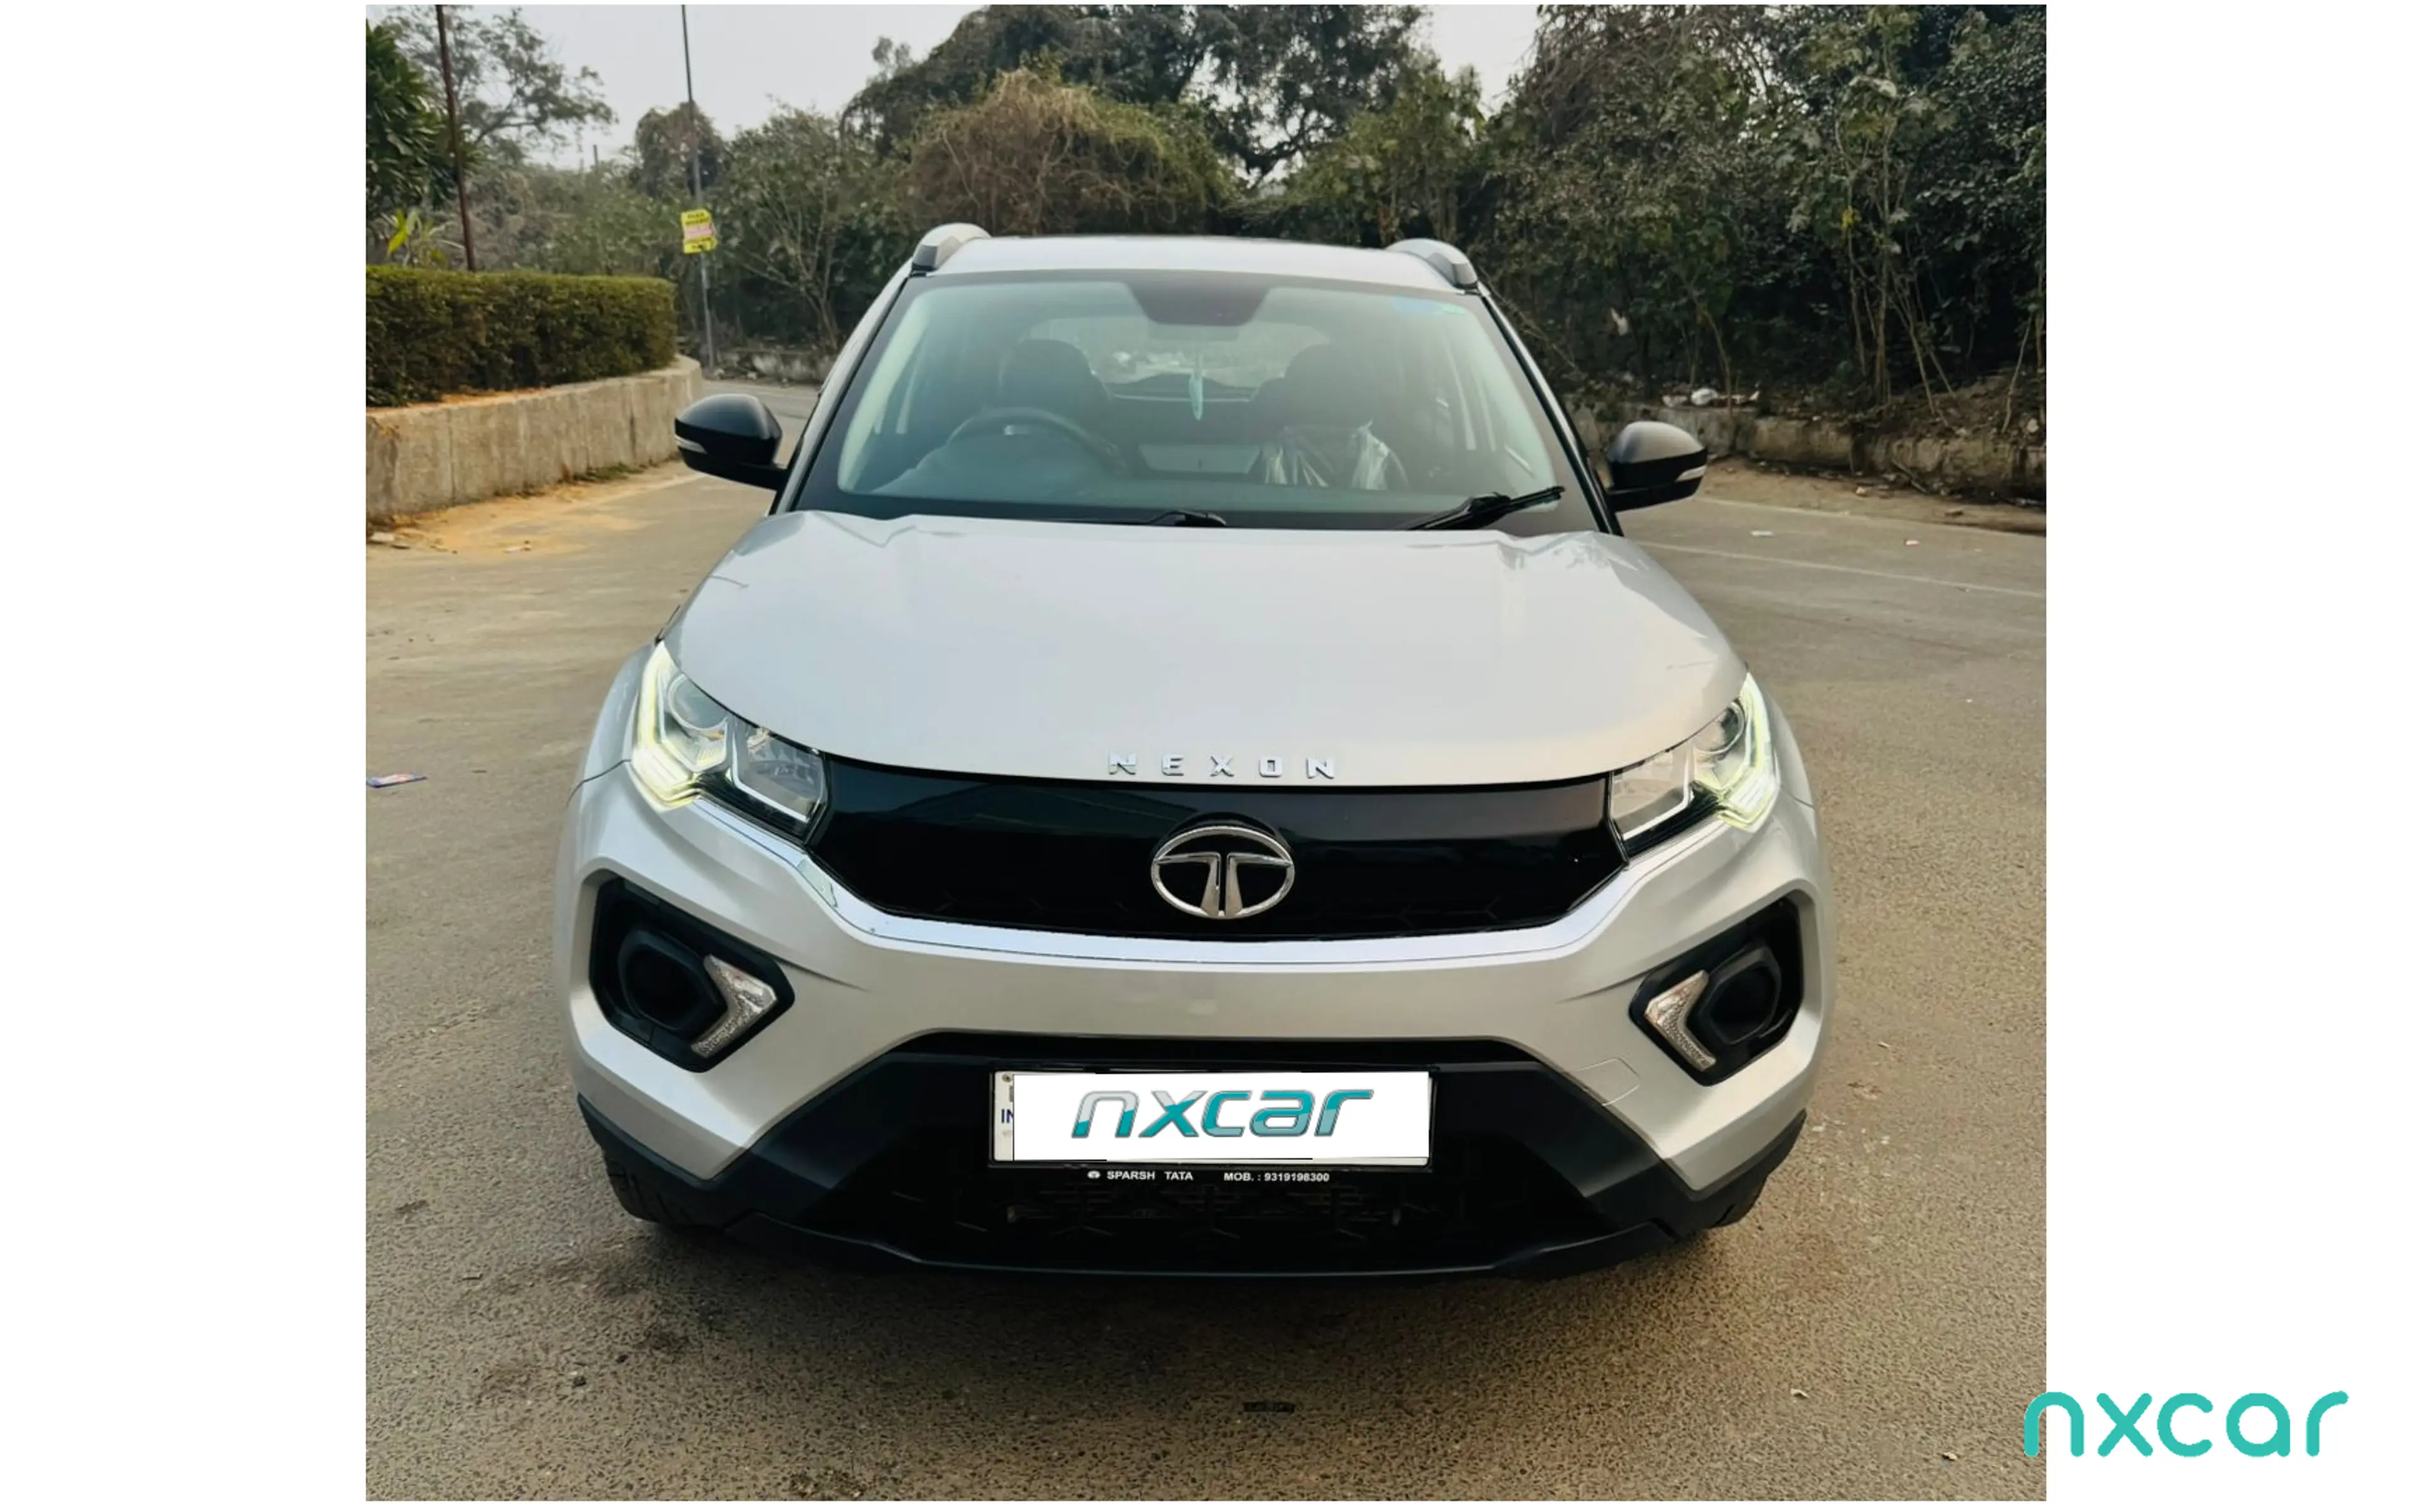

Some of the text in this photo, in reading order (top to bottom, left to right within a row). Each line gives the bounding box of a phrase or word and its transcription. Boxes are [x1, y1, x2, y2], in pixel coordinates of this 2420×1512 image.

[1109, 755, 1335, 779] NEXON
[1107, 1171, 1155, 1180] SPARSH
[1164, 1171, 1194, 1181] TATA
